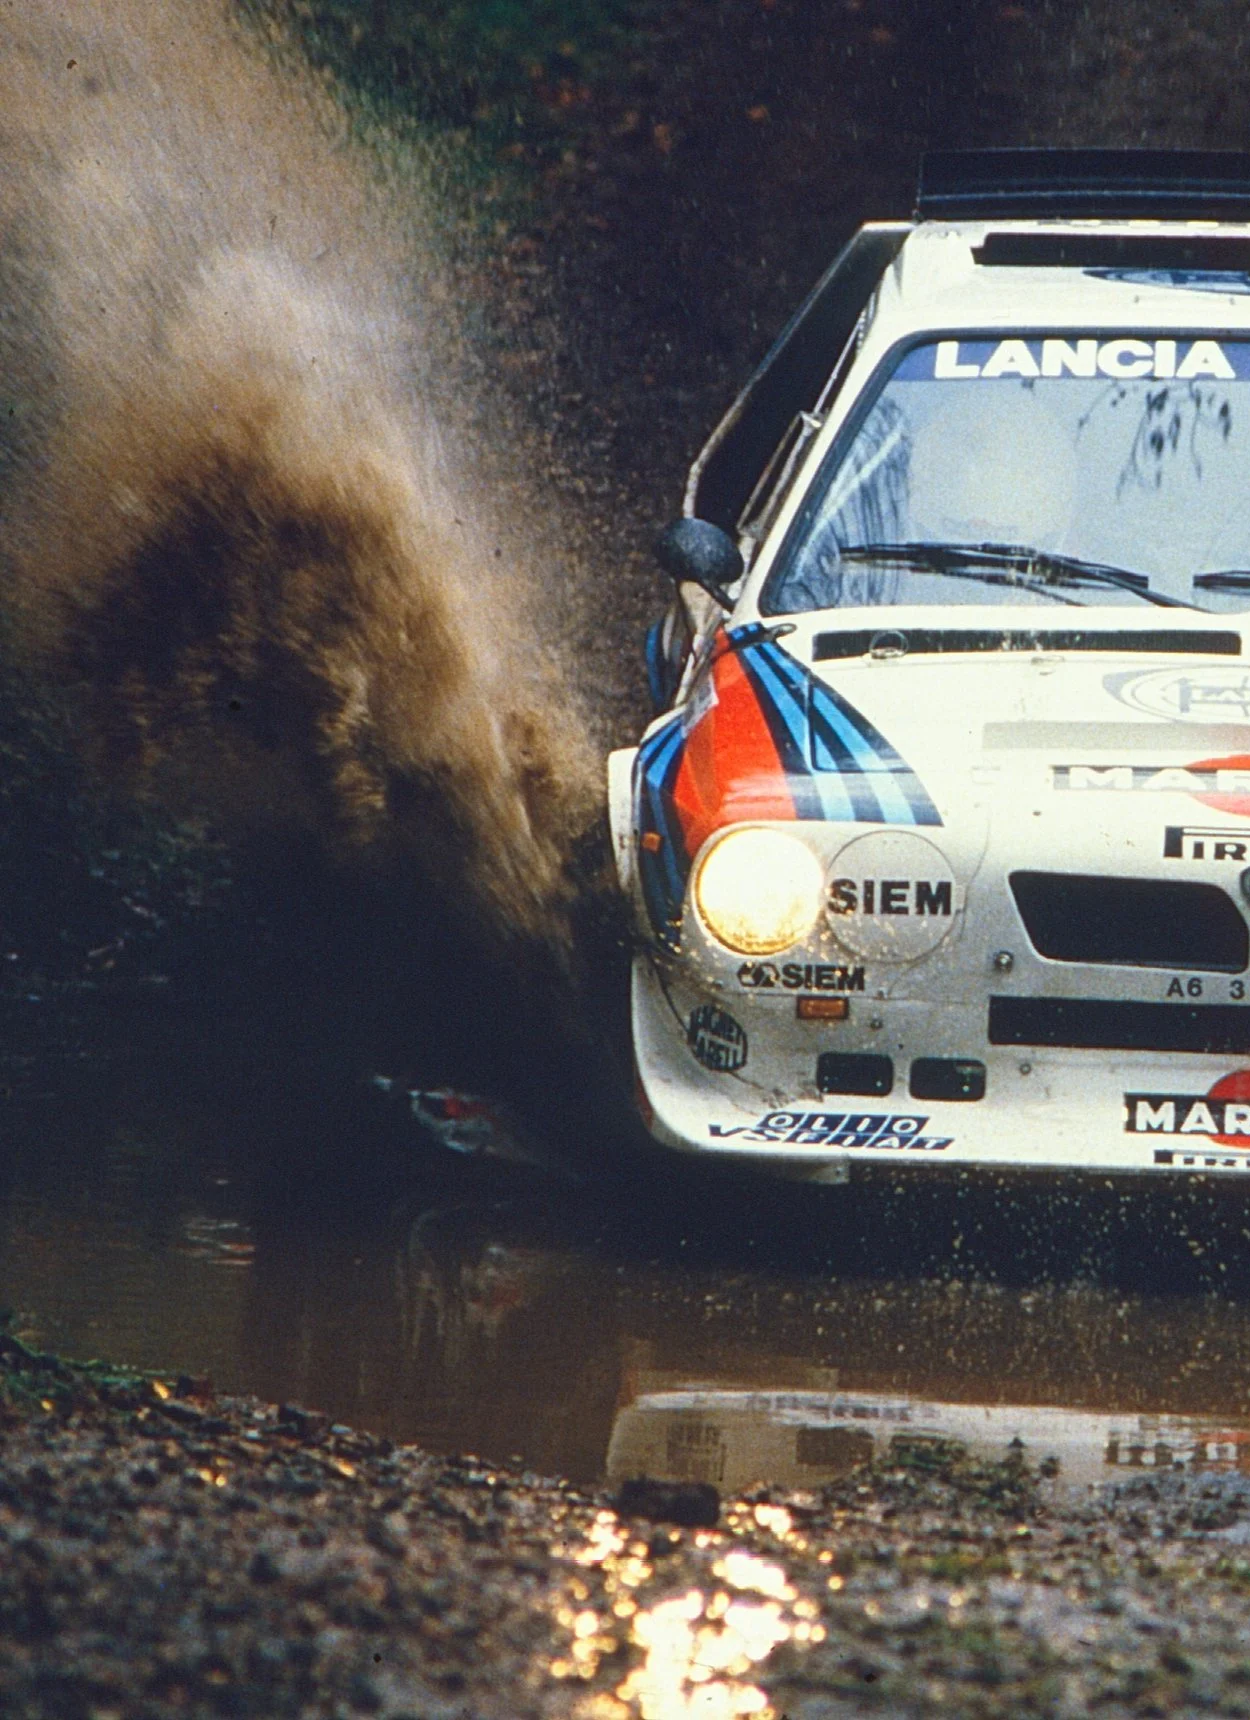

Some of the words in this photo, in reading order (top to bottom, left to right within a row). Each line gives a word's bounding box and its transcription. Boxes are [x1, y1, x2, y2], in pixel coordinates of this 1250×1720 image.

[934, 339, 1236, 379] LANCIA
[827, 877, 952, 915] SIEM
[781, 962, 866, 991] SIEM
[1166, 976, 1203, 998] A6
[762, 1112, 926, 1135] OLIO
